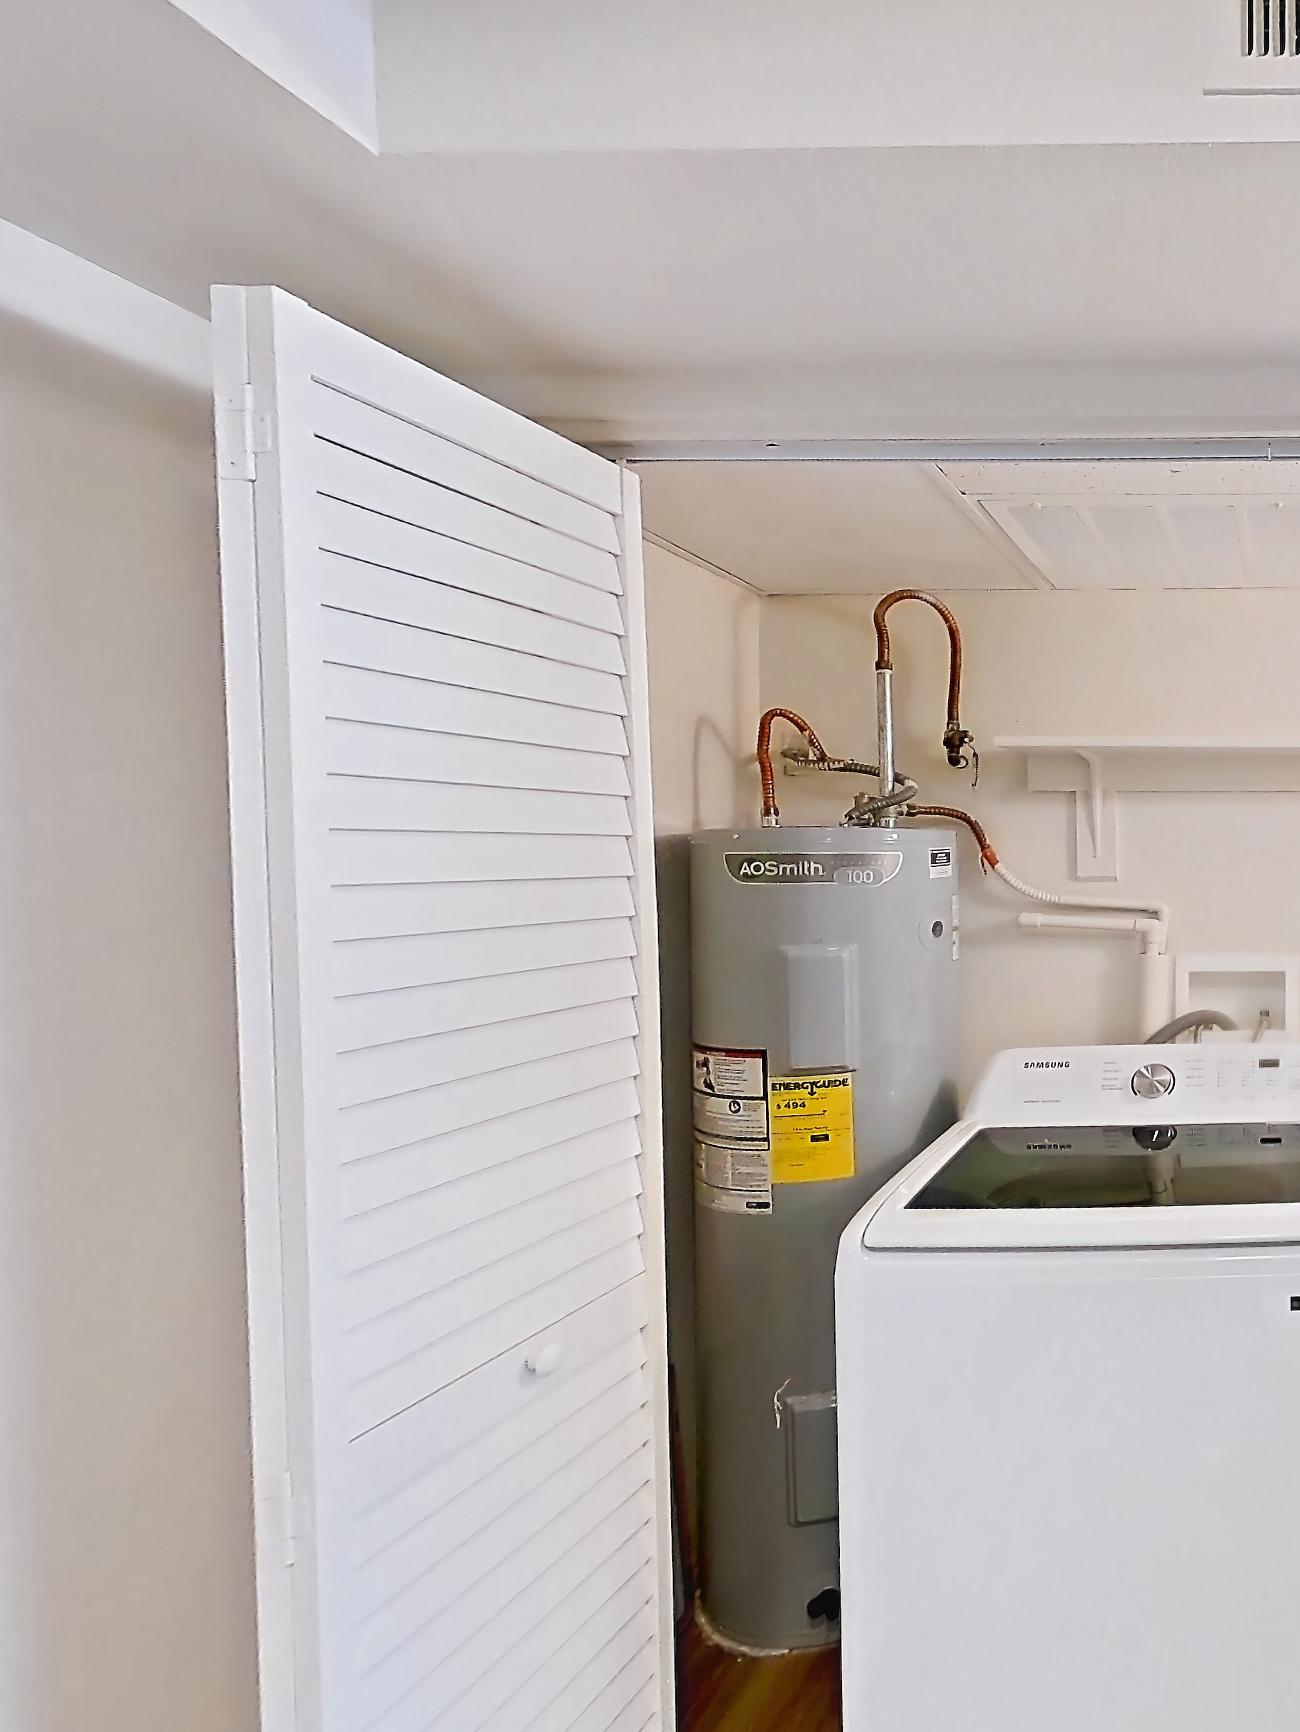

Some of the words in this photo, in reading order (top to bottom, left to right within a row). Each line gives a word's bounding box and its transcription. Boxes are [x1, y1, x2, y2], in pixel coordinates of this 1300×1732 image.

[739, 860, 826, 876] AOSmith
[847, 870, 874, 883] 100
[1023, 1061, 1070, 1069] SAMSUNG
